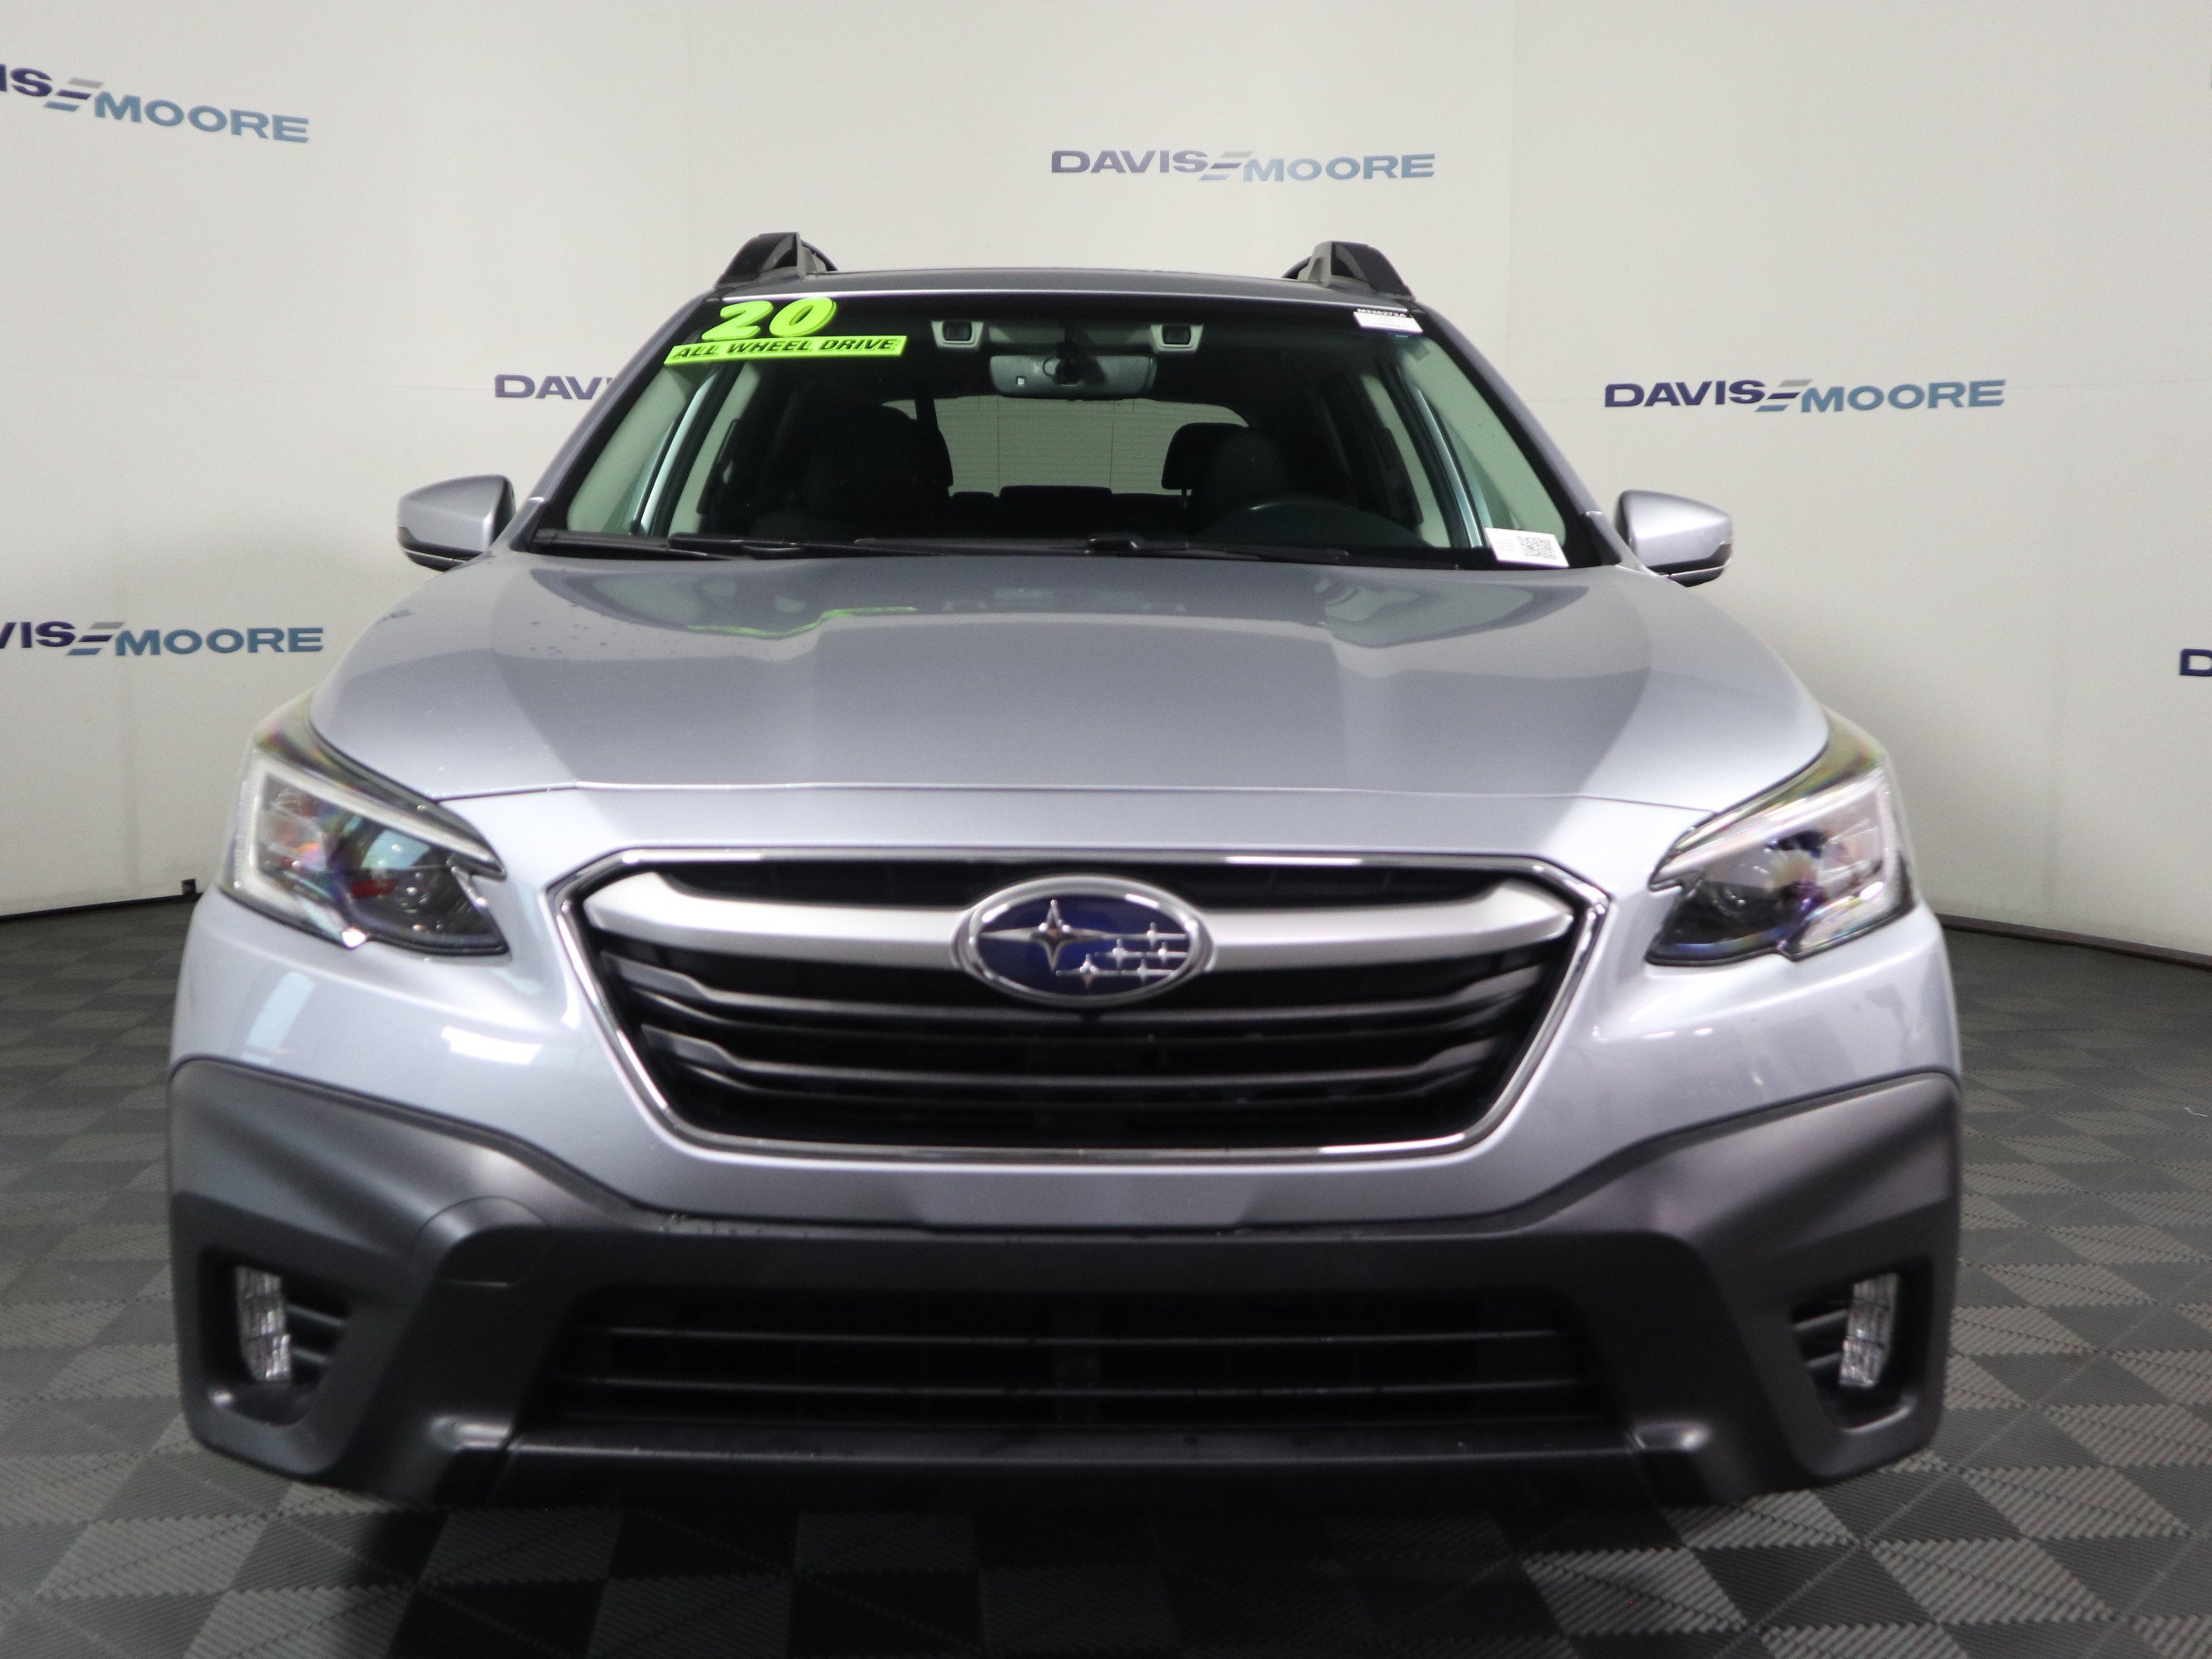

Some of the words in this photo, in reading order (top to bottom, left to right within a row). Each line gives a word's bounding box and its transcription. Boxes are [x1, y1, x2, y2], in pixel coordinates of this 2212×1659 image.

[94, 91, 309, 143] MOORE
[1051, 150, 1208, 174] DAVIS
[1242, 153, 1436, 182] MOORE
[701, 296, 837, 341] 20
[673, 344, 720, 358] ALL
[725, 339, 811, 355] WHEEL
[819, 338, 899, 351] DRIVE
[495, 374, 613, 400] DAV
[1604, 379, 1766, 407] DAVIS
[1801, 379, 2006, 413] MOORE
[115, 627, 324, 656] MOORE
